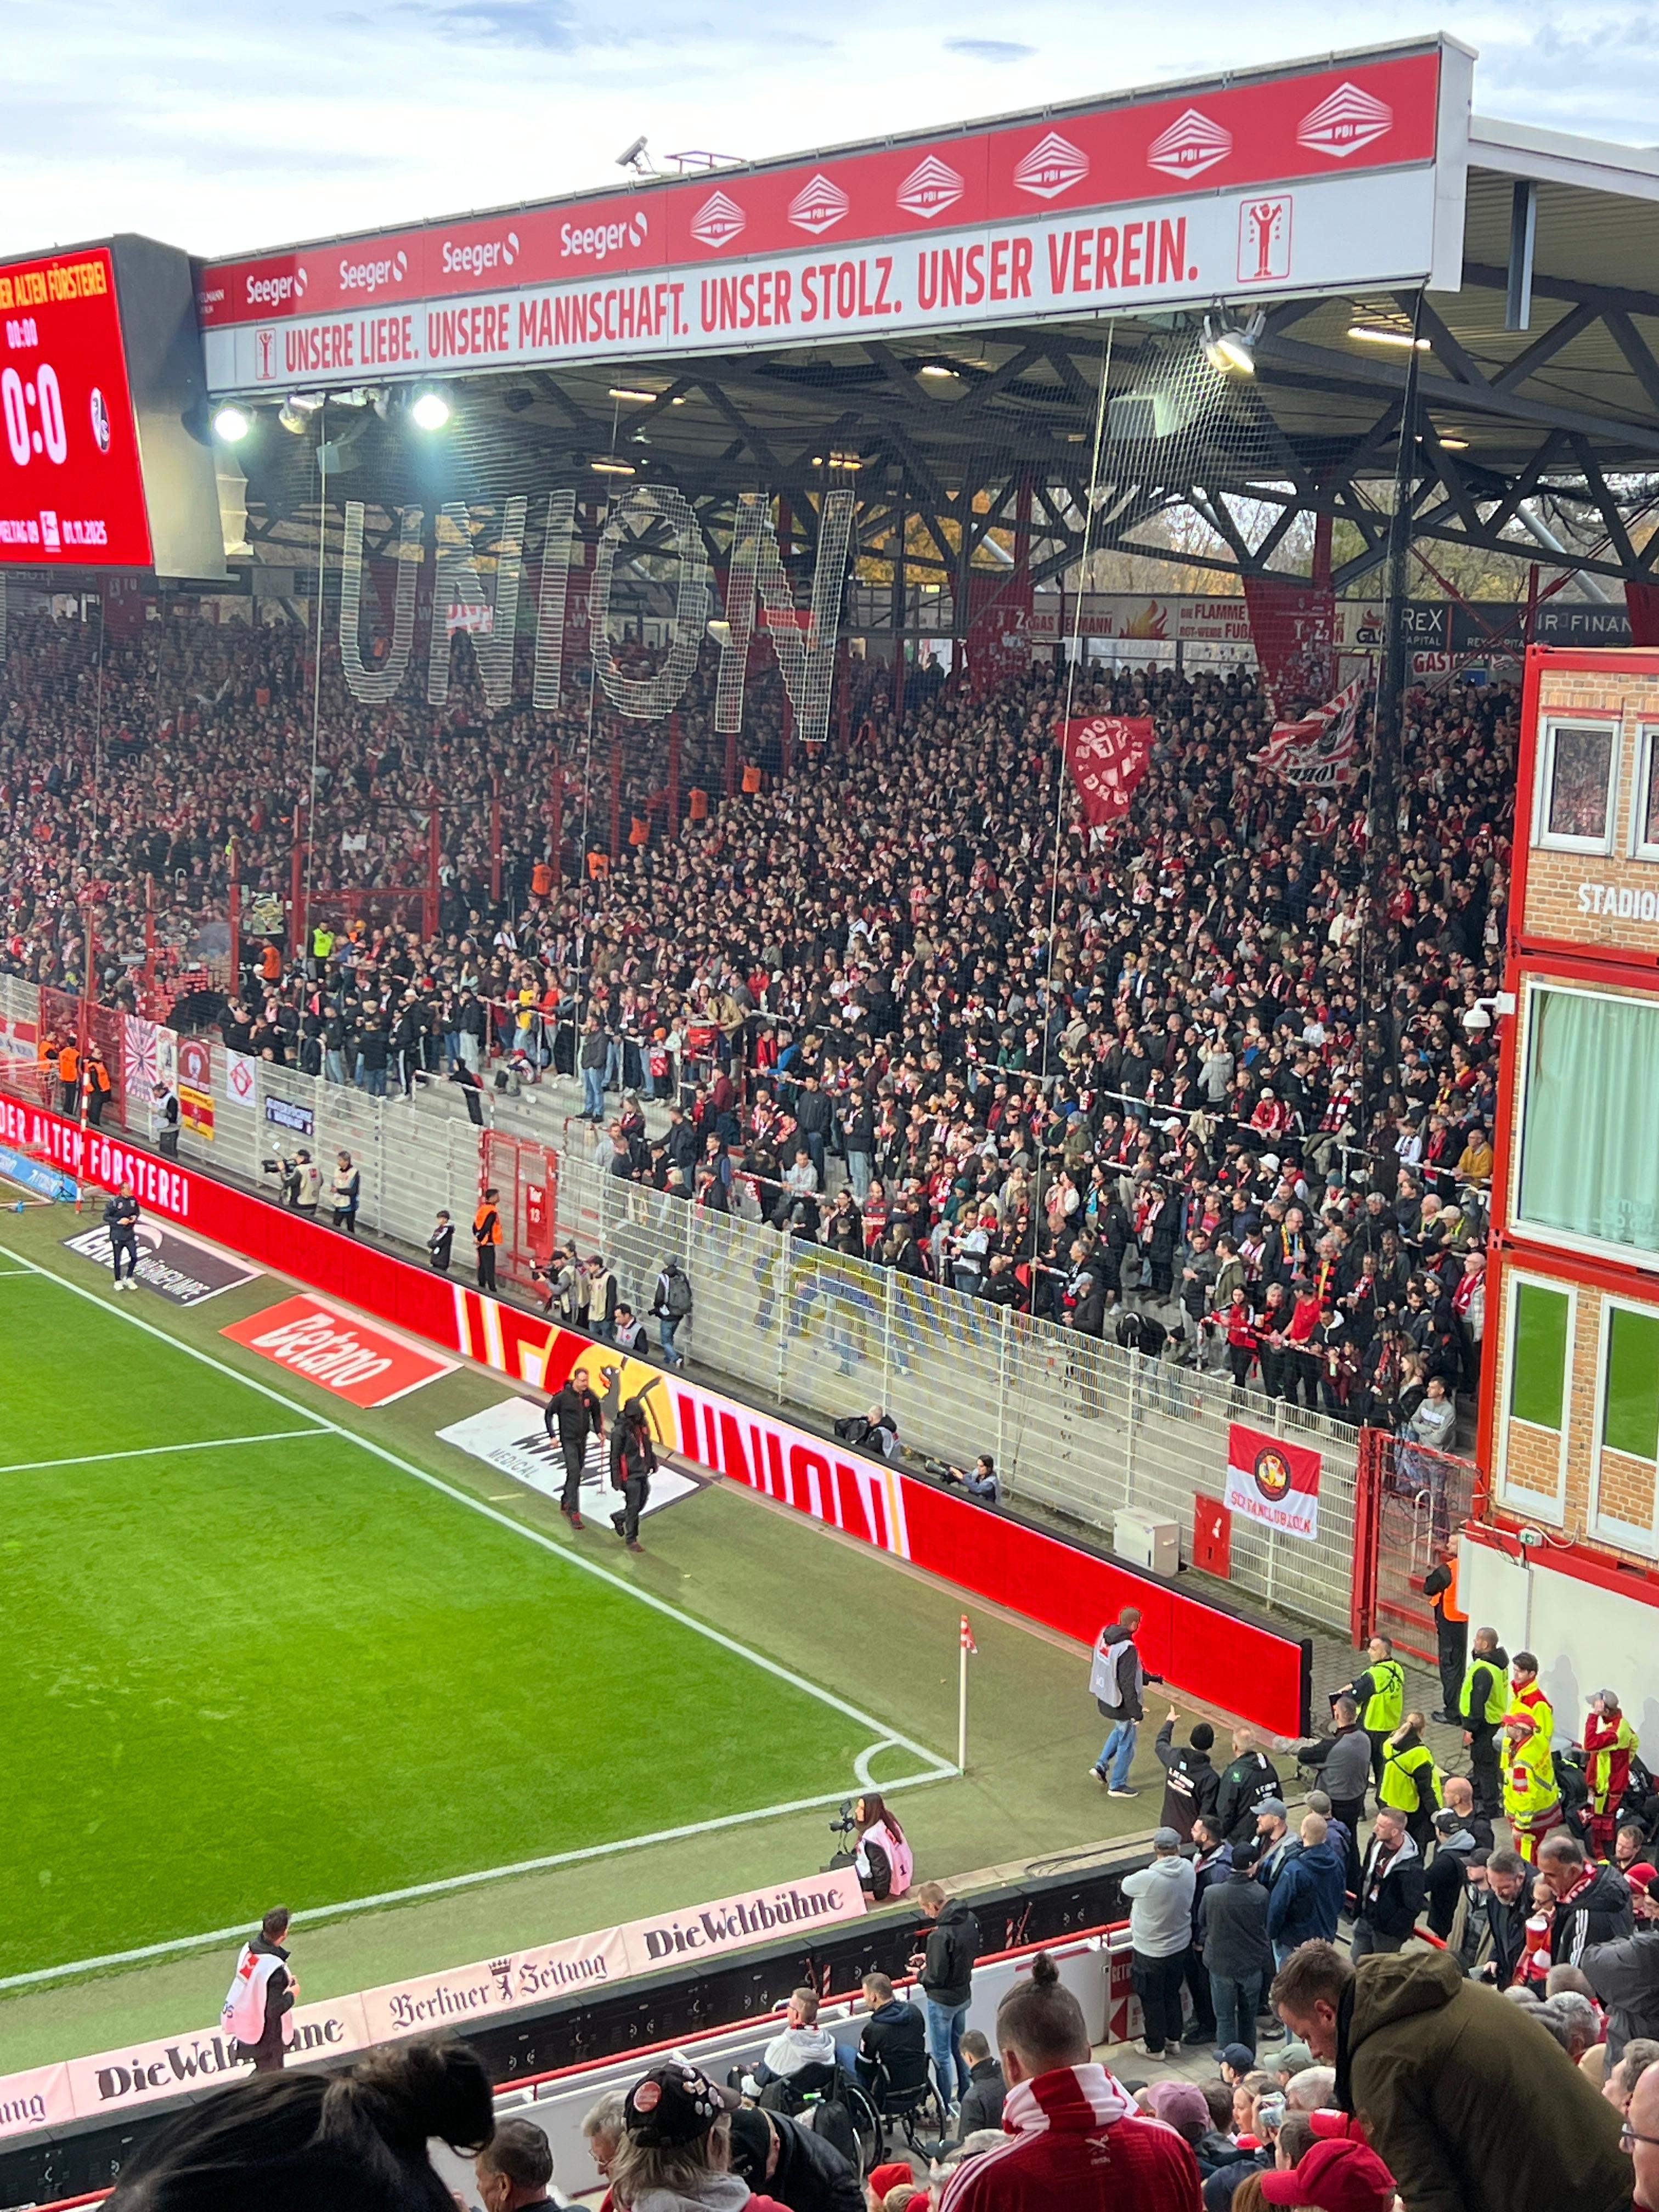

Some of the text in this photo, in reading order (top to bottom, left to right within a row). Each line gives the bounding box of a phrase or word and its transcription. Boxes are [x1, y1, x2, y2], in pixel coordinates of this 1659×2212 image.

[442, 240, 501, 276] Seeger
[561, 222, 628, 259] Seeger
[14, 271, 49, 308] ALTEN
[46, 261, 108, 302] FÖRSTEREI
[246, 275, 295, 306] Seeger
[285, 216, 1199, 373] UNSERE LIEBE. UNSERE MANNSCHAFT. UNSER STOLZ. UNSER VEREIN.
[340, 259, 392, 292] Seeger
[5, 316, 38, 349] 00:00
[1, 363, 67, 466] 0:0
[61, 519, 108, 545] 01.11.2025
[340, 484, 856, 742] UNION
[1195, 604, 1245, 620] FLAMME
[1577, 882, 1659, 922] STADIO
[32, 1115, 84, 1167] ALTEN
[90, 1136, 189, 1216] FÖRSTEREI
[251, 1312, 393, 1388] Betano
[486, 1448, 539, 1479] MEDICAL
[388, 1952, 608, 2032] Berliner Zeitung
